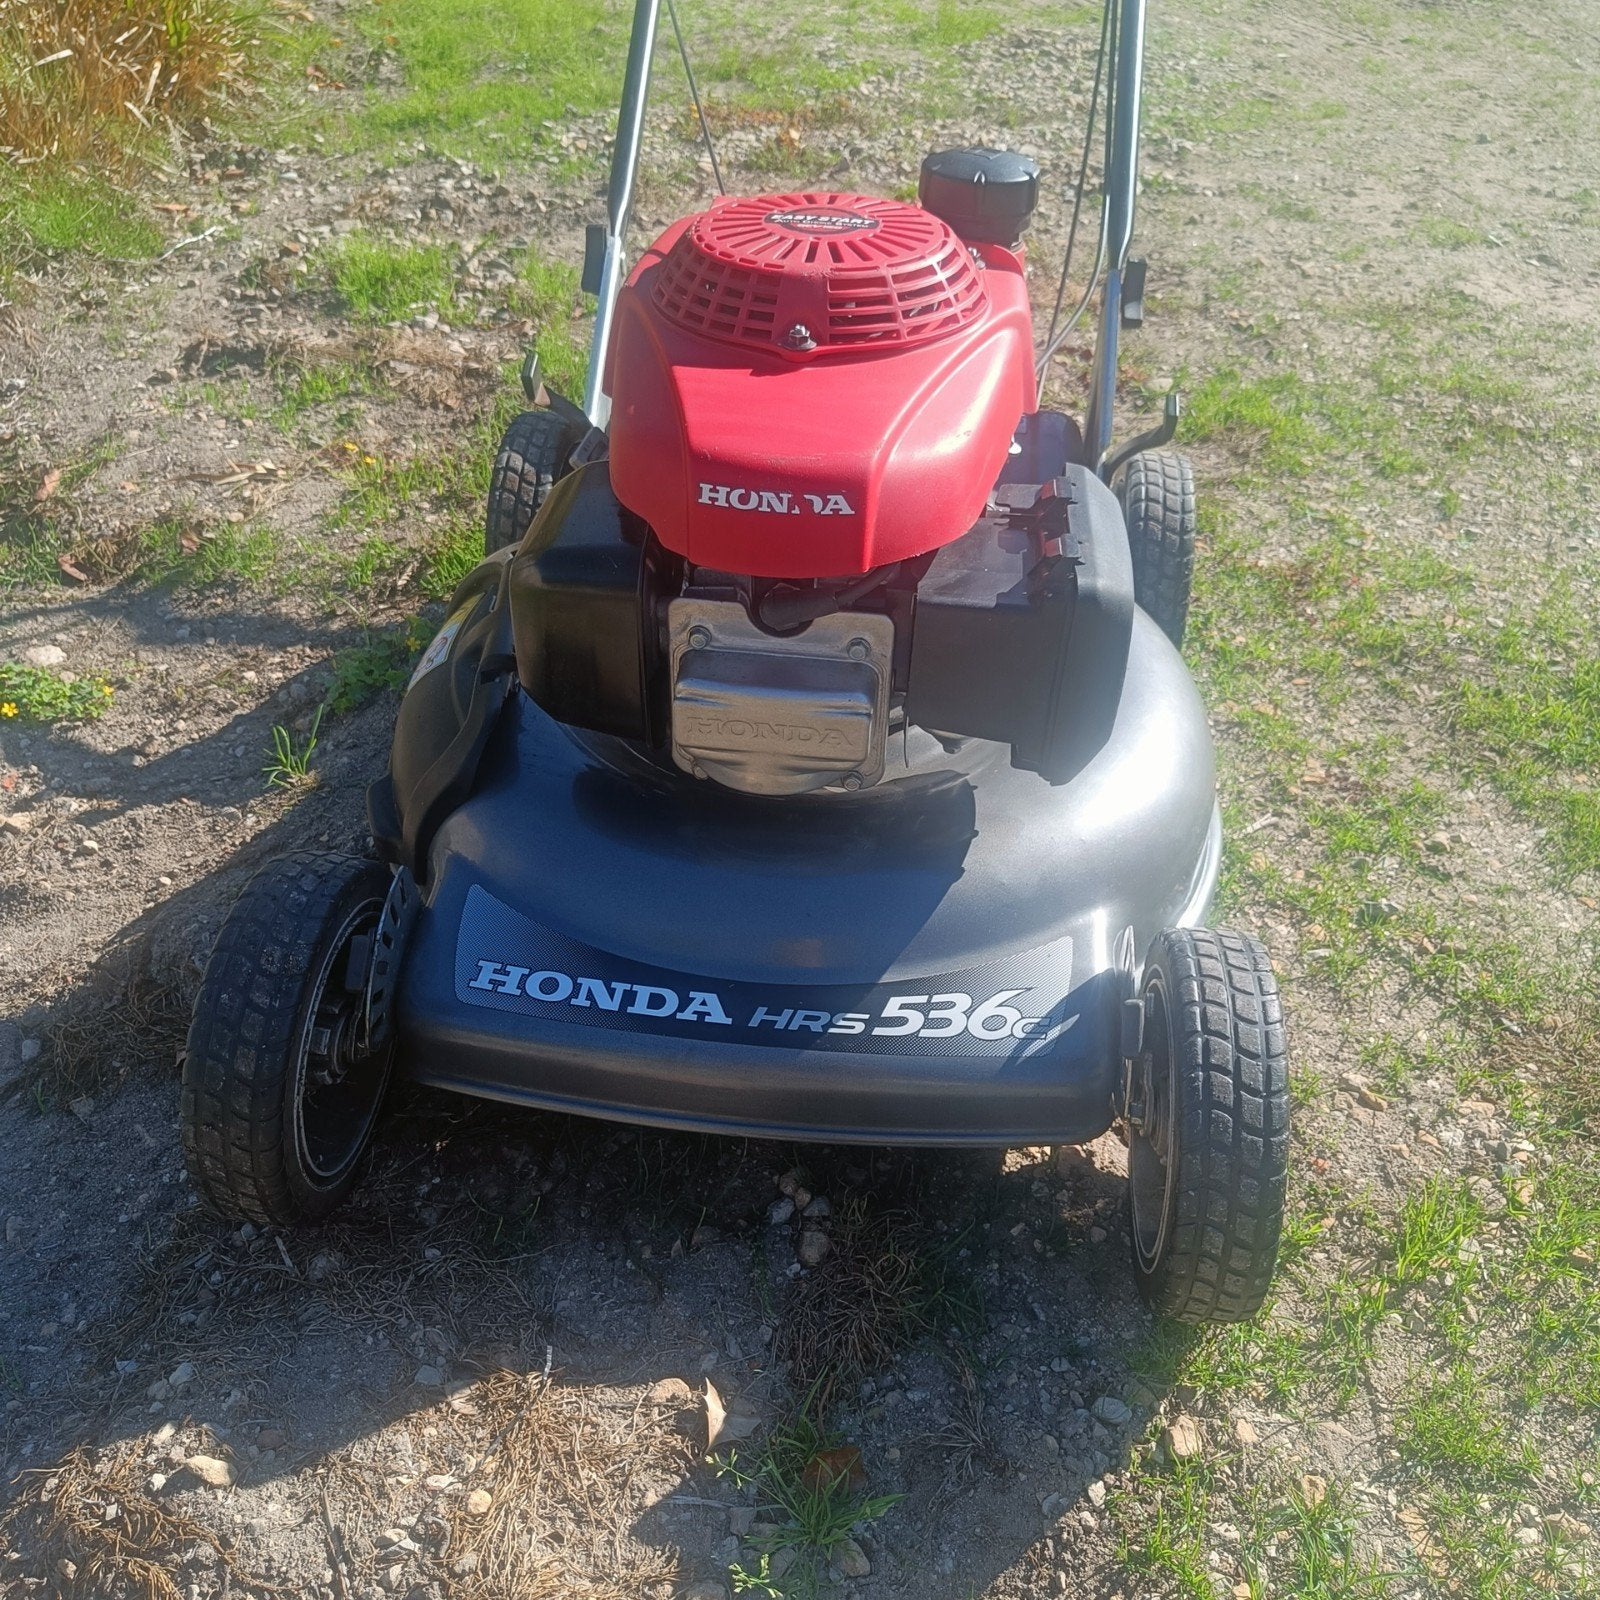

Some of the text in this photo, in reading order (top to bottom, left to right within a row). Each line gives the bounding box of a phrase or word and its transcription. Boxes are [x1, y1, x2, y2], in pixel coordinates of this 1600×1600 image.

[819, 216, 875, 225] START
[686, 716, 853, 746] HONDA
[469, 960, 733, 1025] HONDA
[748, 1006, 870, 1035] HRS
